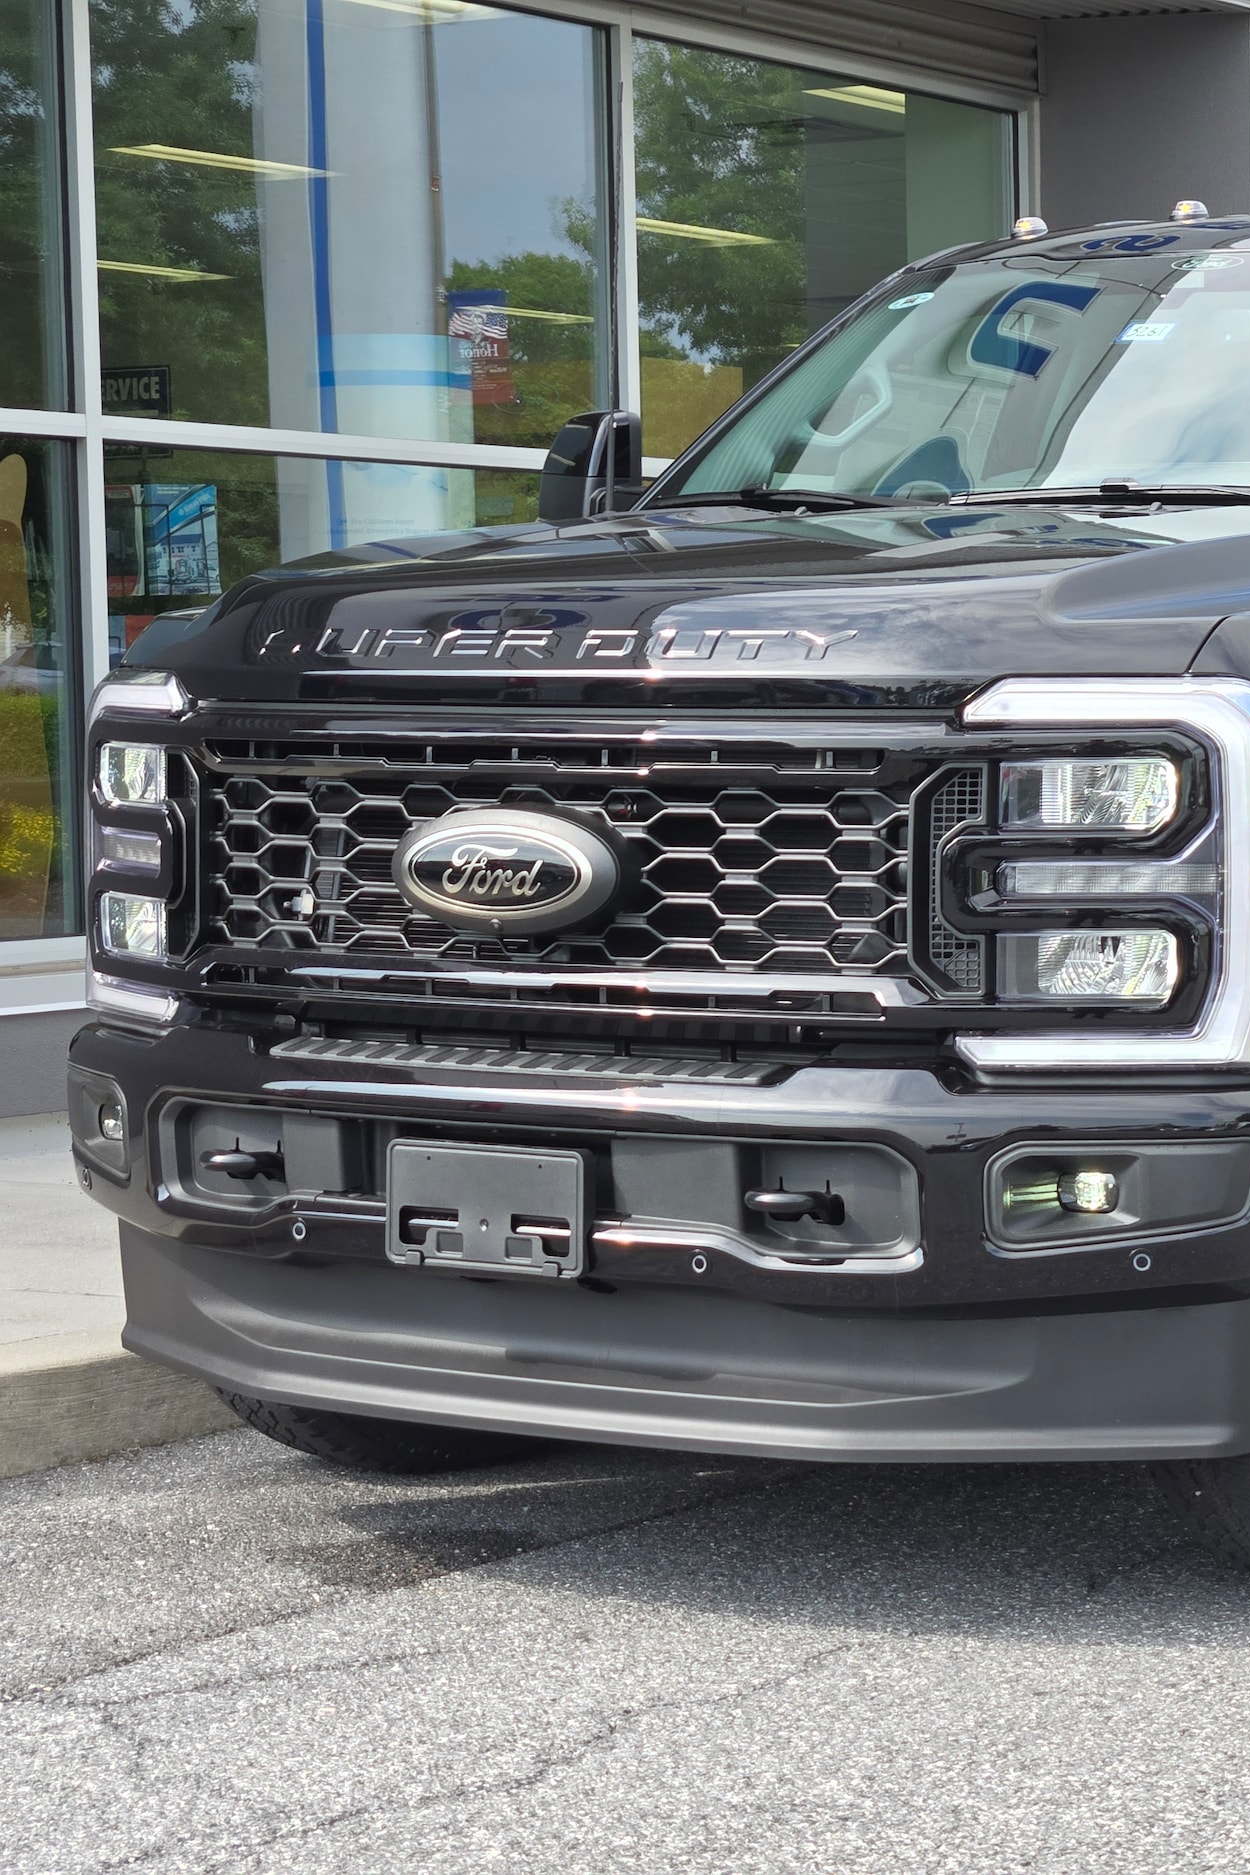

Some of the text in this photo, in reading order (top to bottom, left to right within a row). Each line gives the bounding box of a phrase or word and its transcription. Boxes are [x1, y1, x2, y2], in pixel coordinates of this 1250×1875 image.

[102, 376, 160, 401] RVICE
[257, 628, 858, 661] UPER DUTY
[441, 843, 544, 898] Ford
